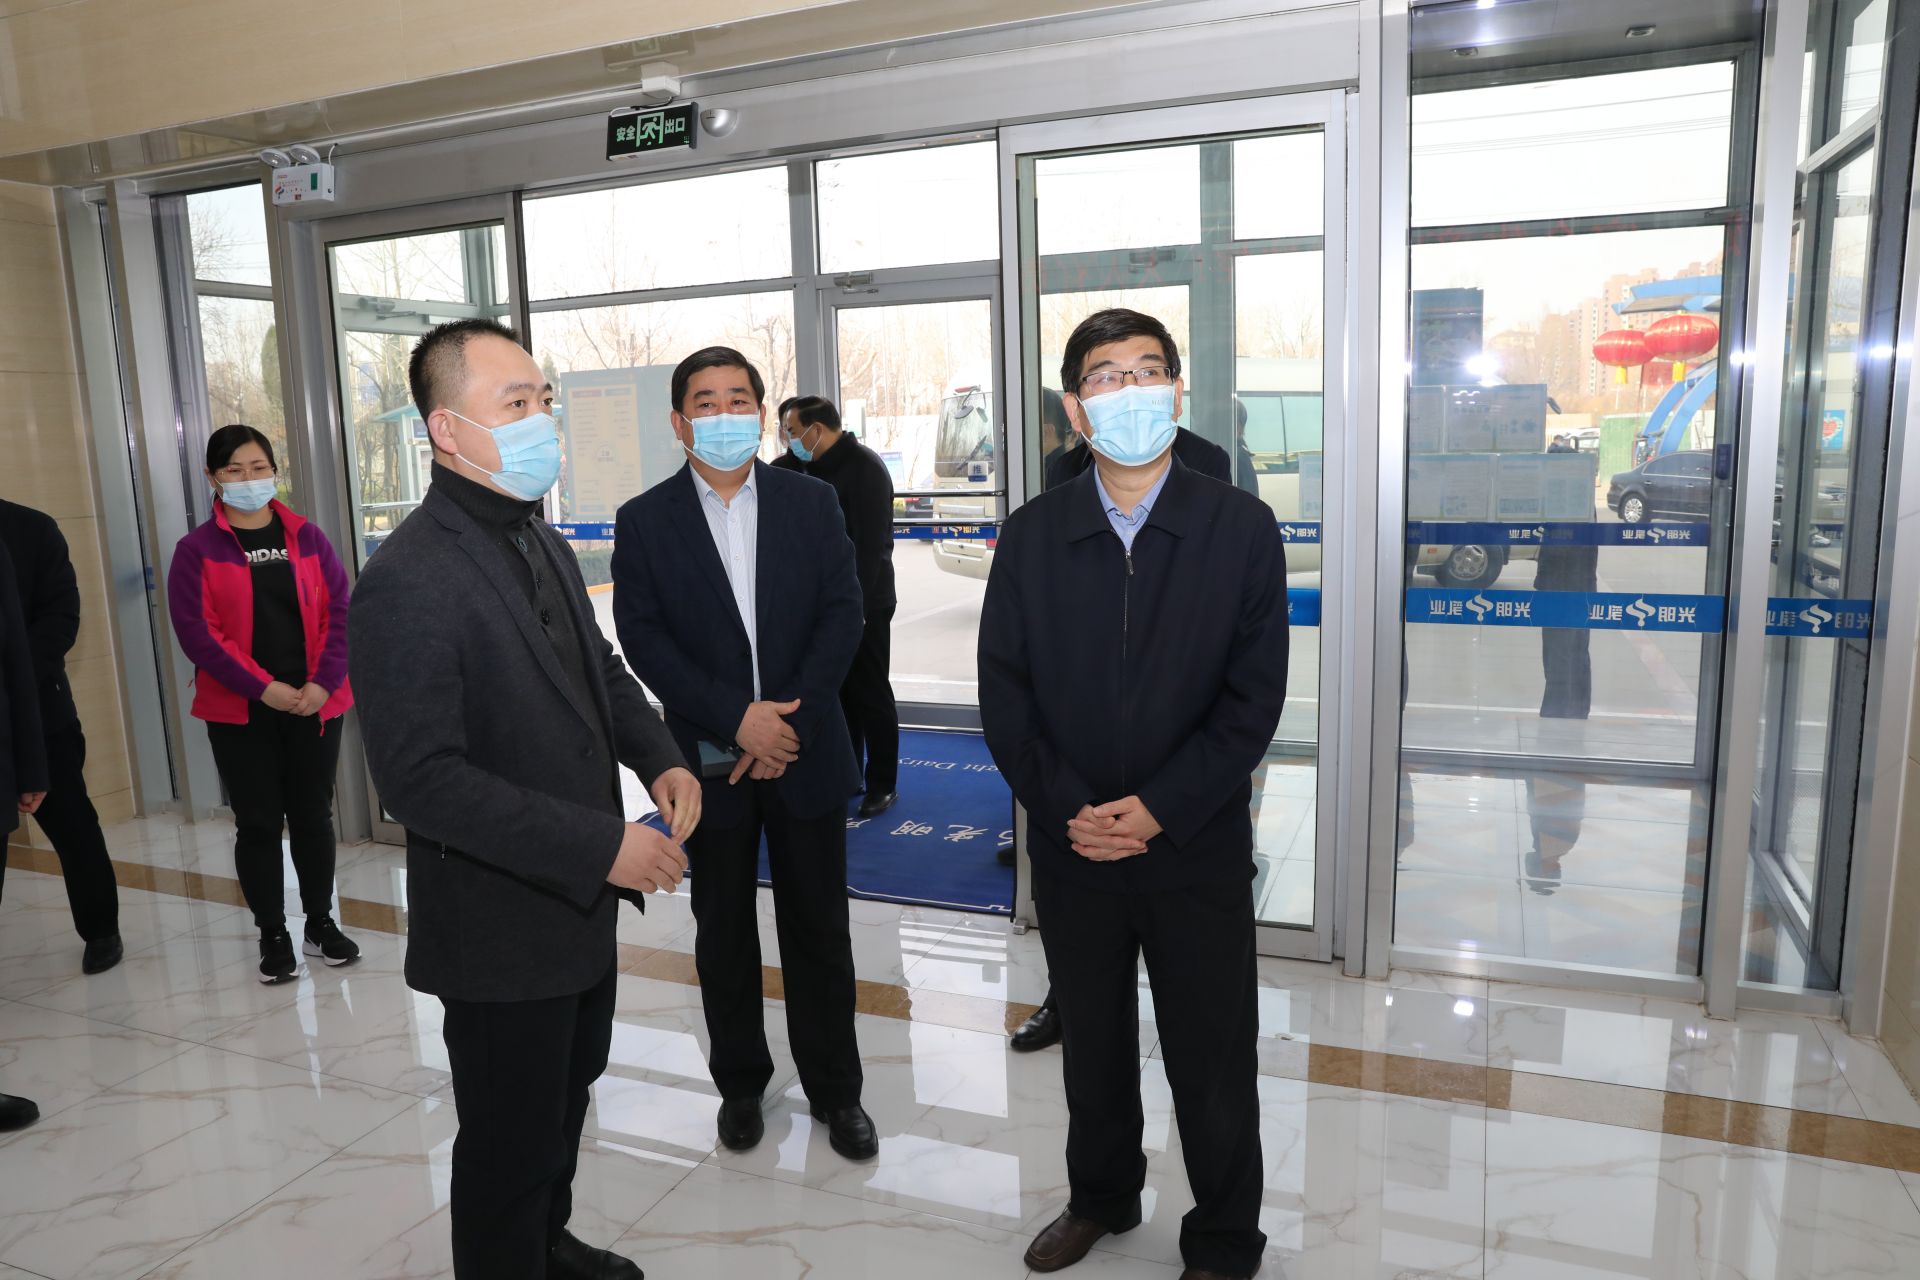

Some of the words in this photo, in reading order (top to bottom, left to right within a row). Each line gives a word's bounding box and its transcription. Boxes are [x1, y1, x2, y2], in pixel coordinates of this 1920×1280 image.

[616, 125, 636, 142] 安全
[664, 117, 686, 134] 出口
[244, 548, 289, 563] DIDAS
